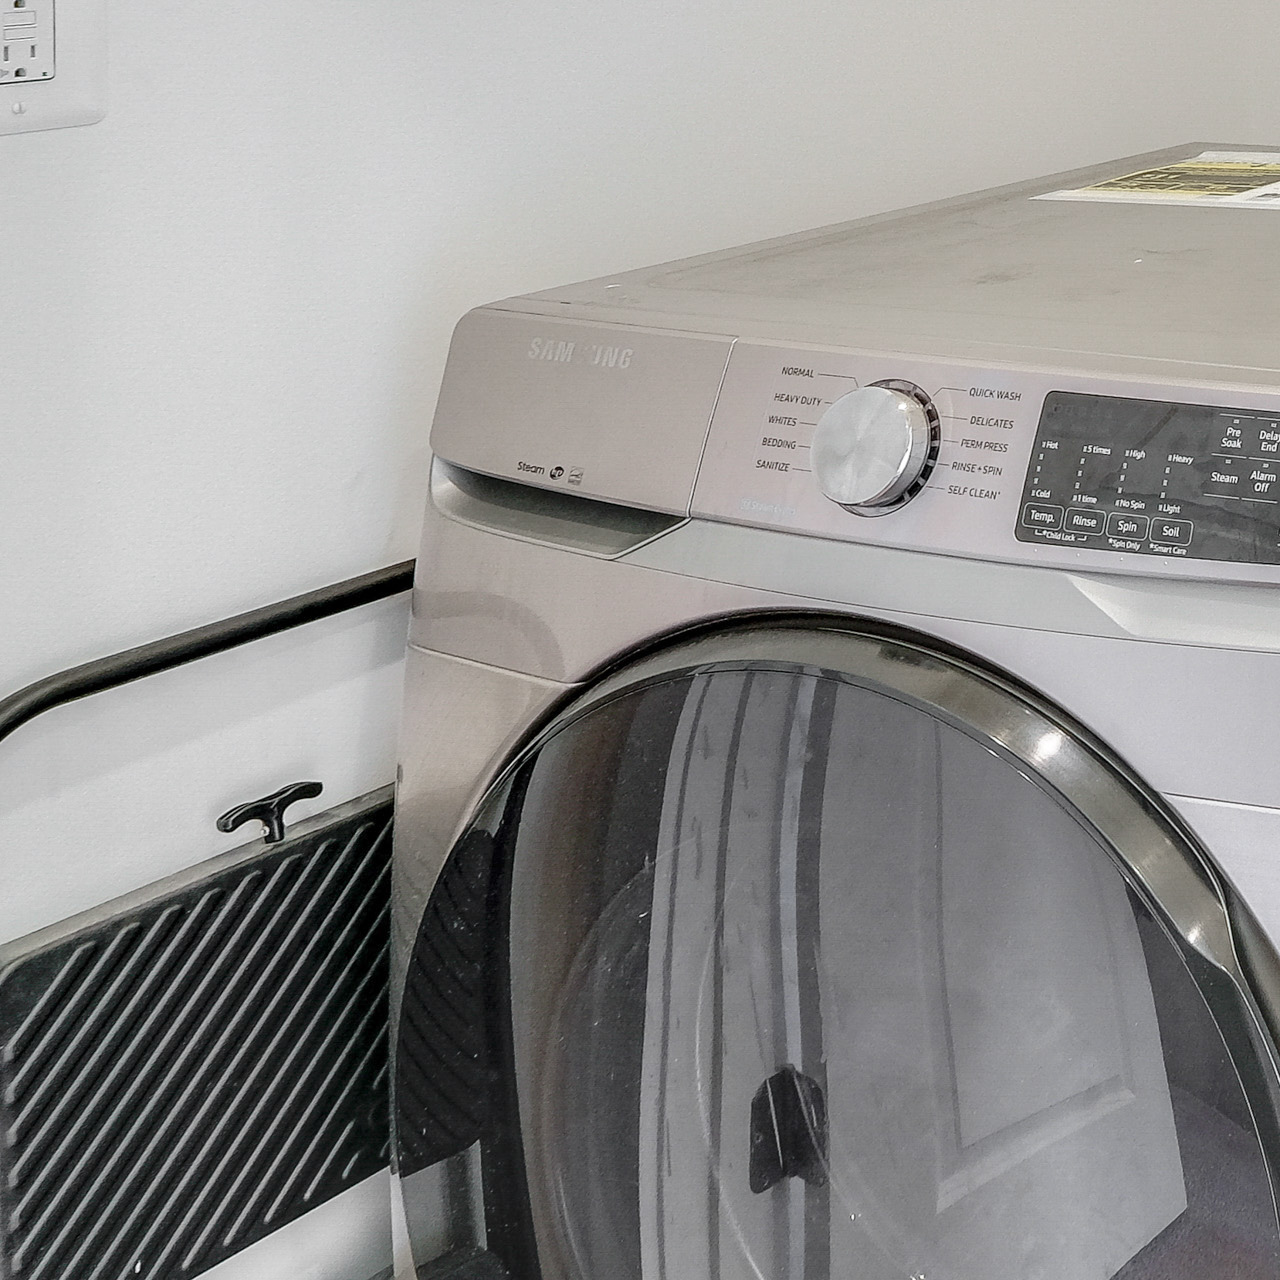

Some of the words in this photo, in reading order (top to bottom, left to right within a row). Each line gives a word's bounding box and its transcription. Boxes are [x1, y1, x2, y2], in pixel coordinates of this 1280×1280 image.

[529, 337, 634, 369] SAMNG
[782, 367, 814, 378] NORMAL
[774, 393, 800, 404] HEAVY
[801, 396, 822, 406] DUTY
[969, 387, 995, 398] QUICK
[997, 390, 1021, 401] WASH
[768, 415, 797, 427] WHITES
[970, 415, 1014, 429] DELICATES
[1226, 427, 1241, 437] Pre
[762, 437, 796, 450] BEDDING
[961, 439, 983, 449] PERM
[984, 442, 1009, 453] PRESS
[1046, 441, 1059, 450] Hot
[1221, 438, 1242, 448] Soak
[1261, 442, 1277, 452] End
[1093, 447, 1111, 455] times
[1129, 450, 1145, 460] High
[756, 459, 790, 472] SANITIZE
[1172, 455, 1194, 465] Heavy
[517, 461, 545, 475] Steam
[952, 462, 975, 473] RINSE
[983, 465, 1003, 476] SPIN
[1211, 472, 1238, 484] Steam
[1250, 471, 1276, 482] Alarm
[948, 485, 968, 496] SELF
[1254, 483, 1270, 492] Off
[1036, 490, 1051, 498] Cold
[1082, 496, 1097, 504] time
[1119, 499, 1130, 508] No
[1131, 500, 1145, 510] Spin
[1163, 505, 1181, 514] Light
[1031, 510, 1055, 523] Temp.
[1073, 515, 1097, 528] Rinse
[1118, 521, 1137, 533] Spin
[1163, 525, 1180, 537] Soil
[1062, 533, 1075, 542] Lock
[1126, 541, 1140, 551] Only
[1172, 547, 1187, 555] Care
